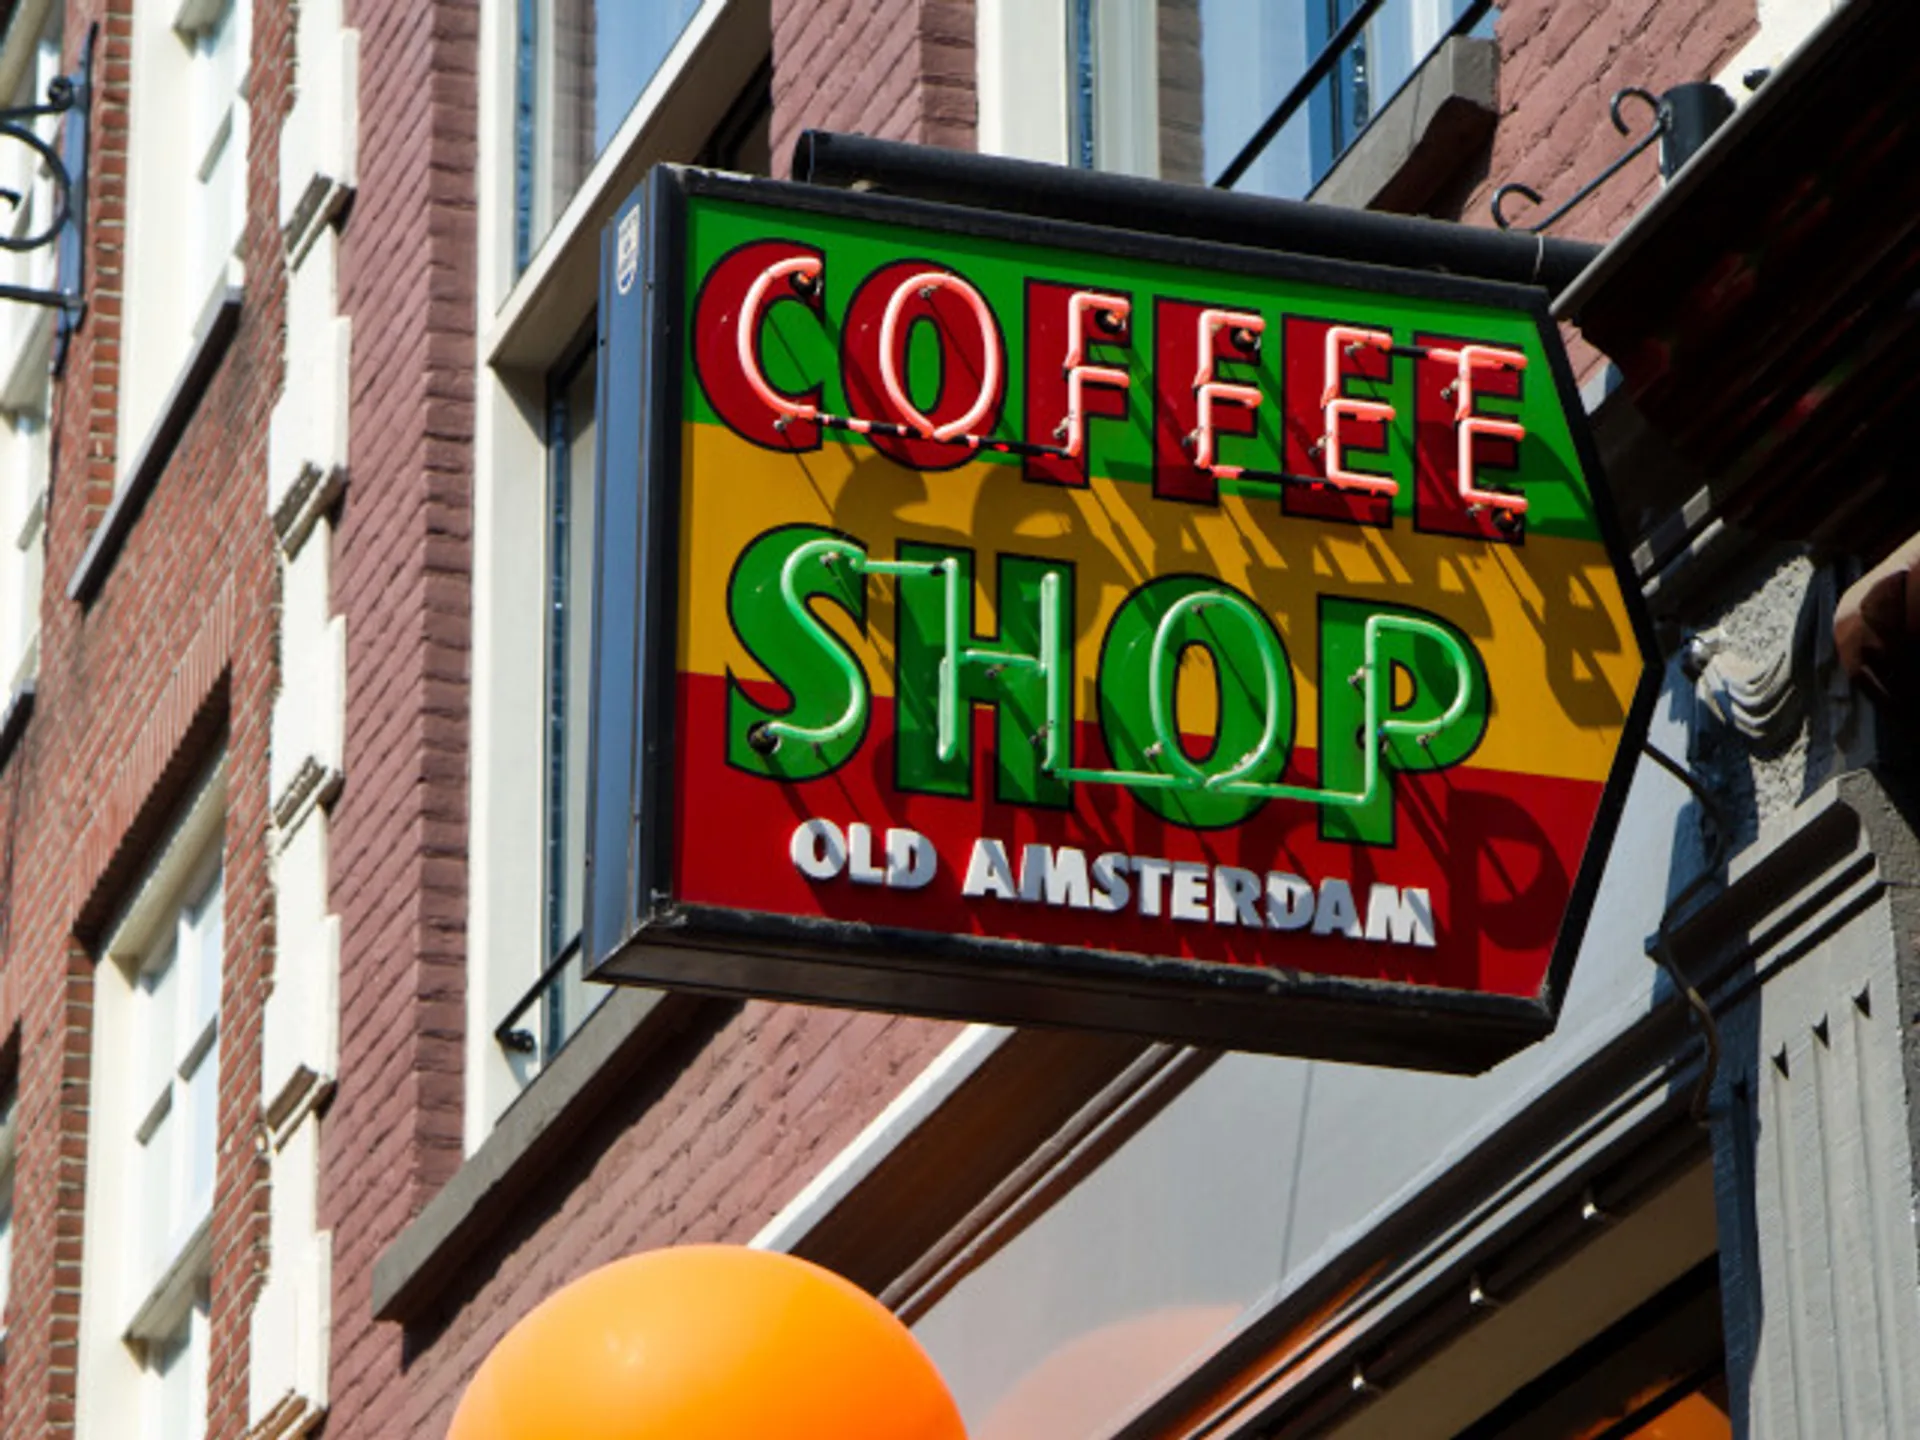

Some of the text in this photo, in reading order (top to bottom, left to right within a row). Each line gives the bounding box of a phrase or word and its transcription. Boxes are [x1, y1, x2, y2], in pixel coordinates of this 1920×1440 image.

[691, 238, 1528, 545] COFFEE
[725, 523, 1491, 848] SHOP
[790, 818, 1436, 947] OLD AMSTERDAM
